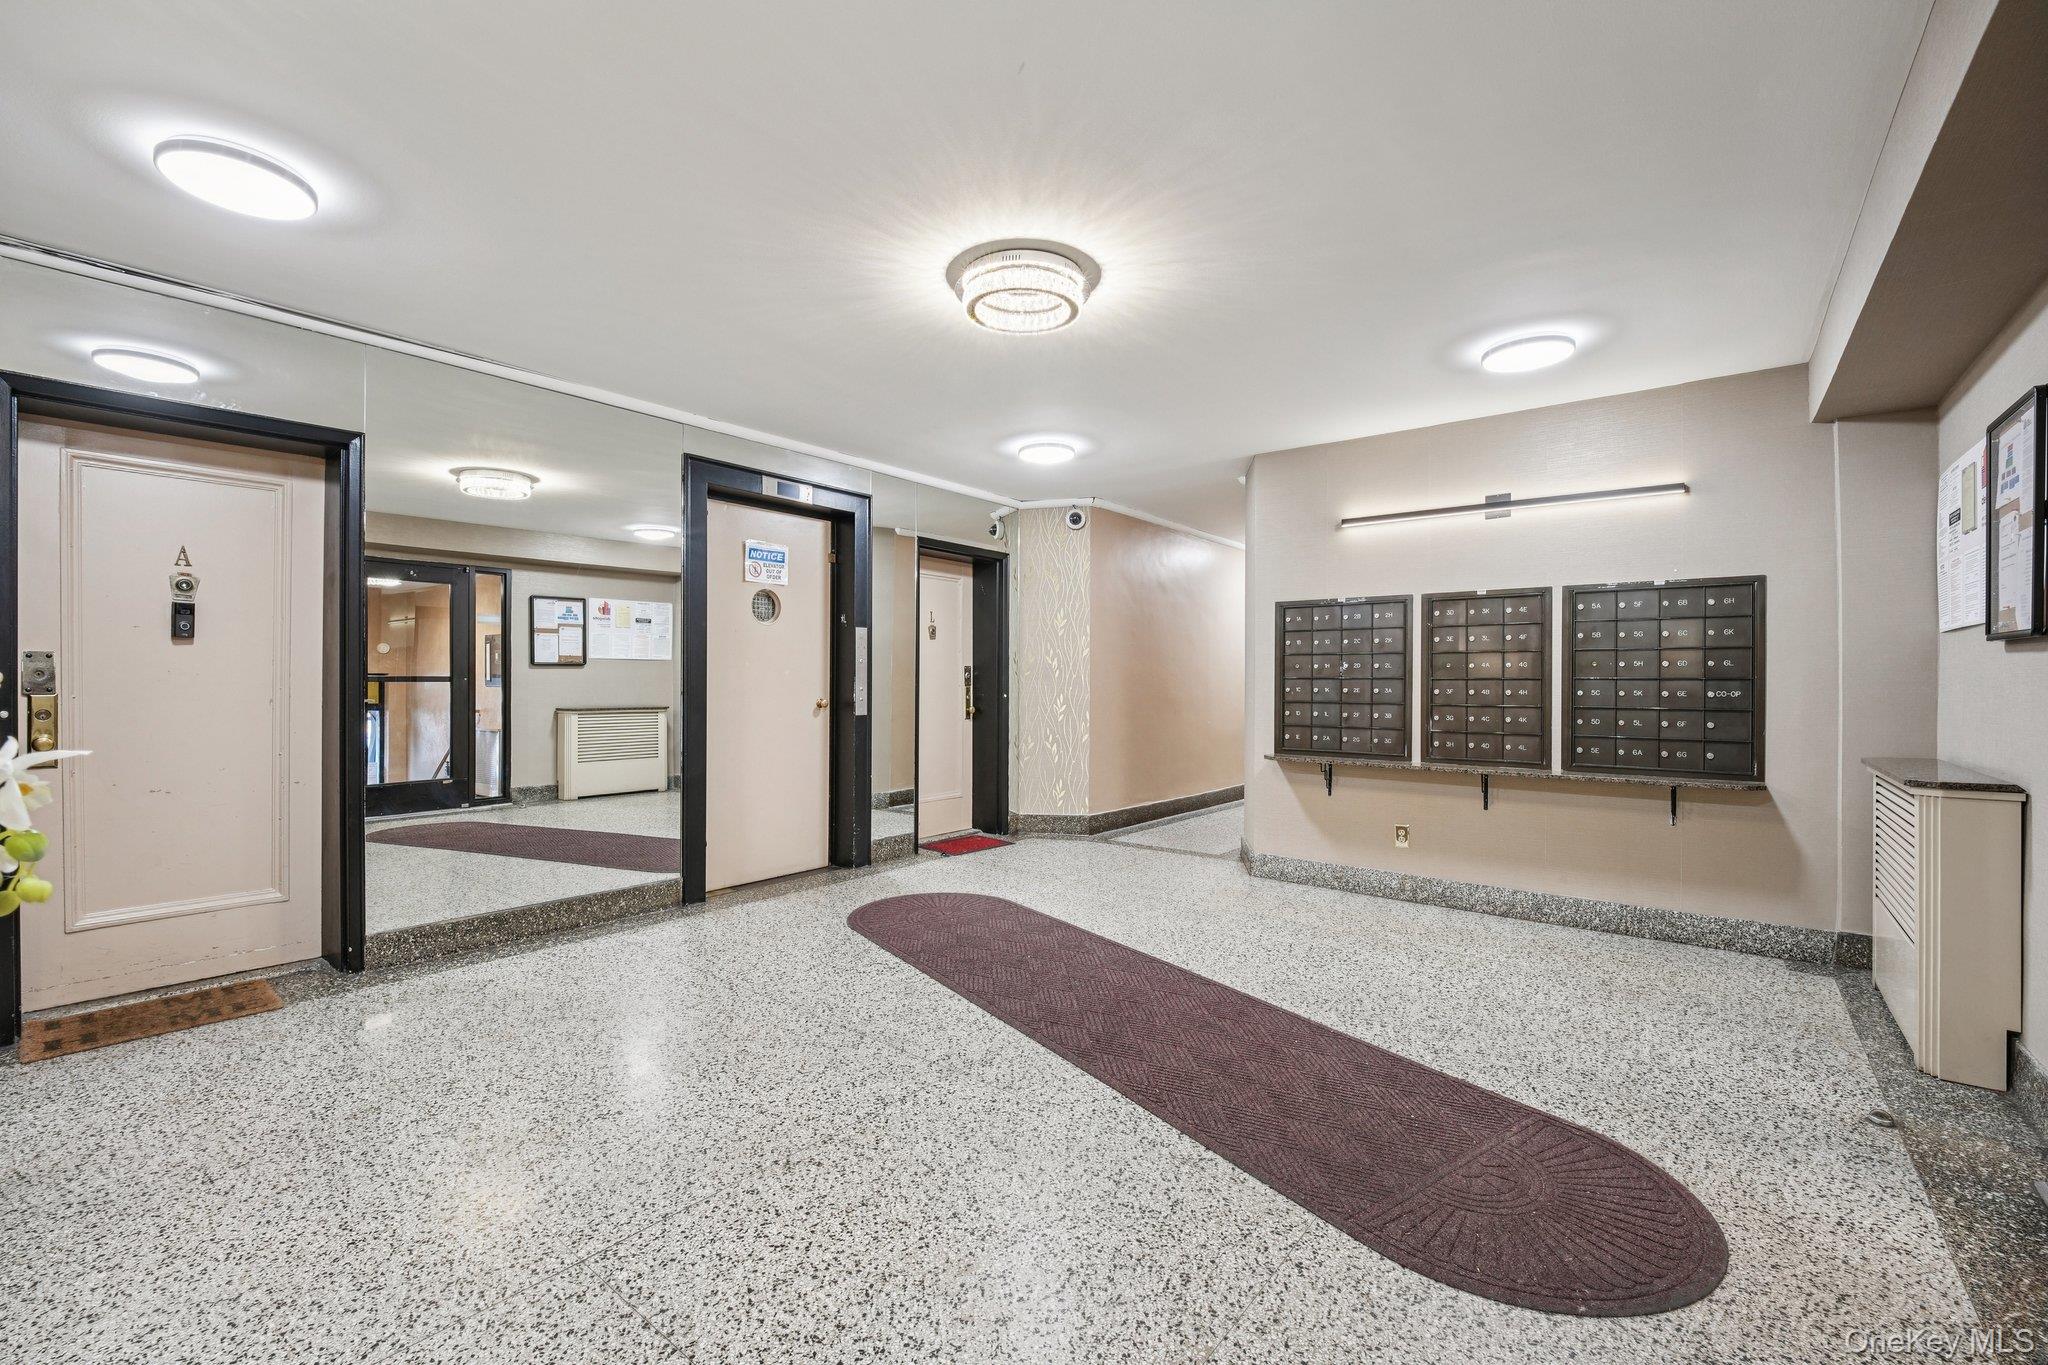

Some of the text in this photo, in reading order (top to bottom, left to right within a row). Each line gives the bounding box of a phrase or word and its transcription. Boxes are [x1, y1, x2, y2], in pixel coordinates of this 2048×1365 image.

[174, 545, 192, 567] A
[750, 550, 784, 561] NOTICE
[930, 610, 935, 623] L
